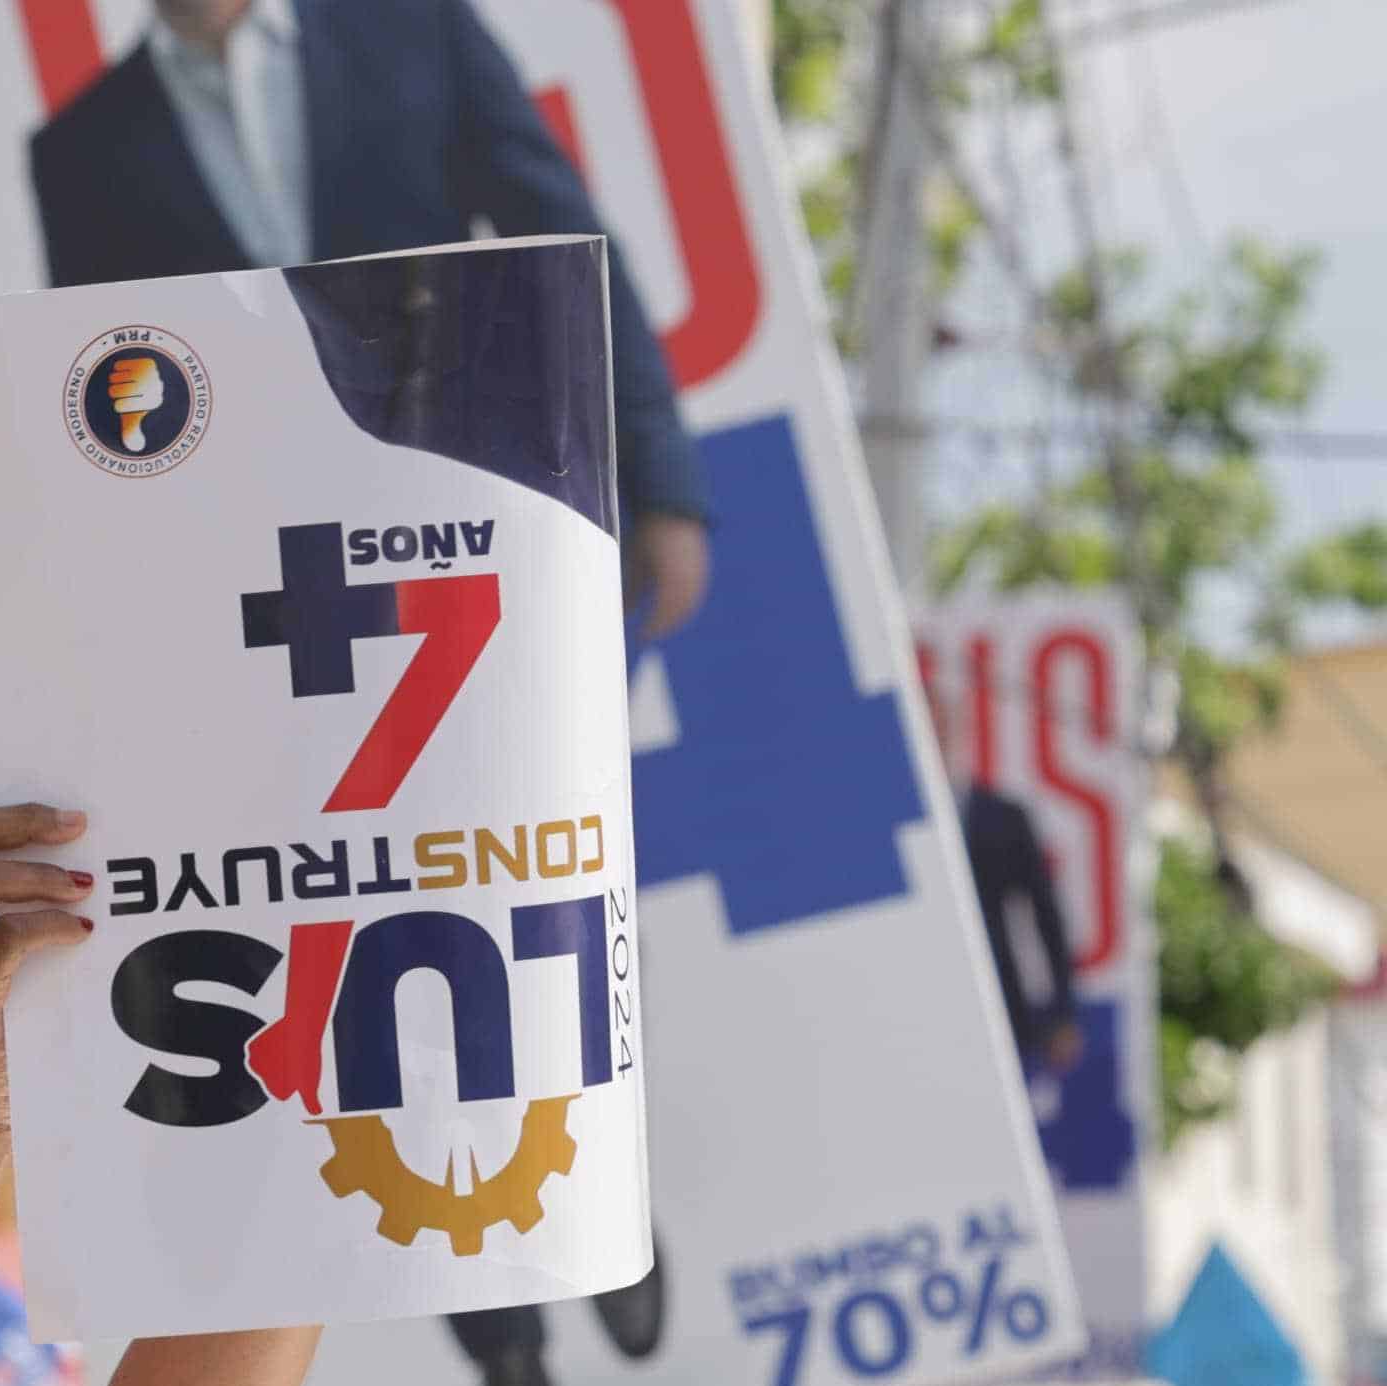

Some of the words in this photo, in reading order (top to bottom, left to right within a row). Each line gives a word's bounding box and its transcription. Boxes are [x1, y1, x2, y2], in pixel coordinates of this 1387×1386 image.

[113, 329, 151, 345] PRM
[66, 366, 87, 442] MODERNO
[182, 355, 208, 419] PARTIDO
[85, 424, 203, 474] REVOLUCIONARIO
[349, 519, 496, 571] AÑOS
[106, 814, 604, 917] CONSTRUYE
[110, 893, 614, 1128] LUIS
[609, 887, 634, 1080] 2024
